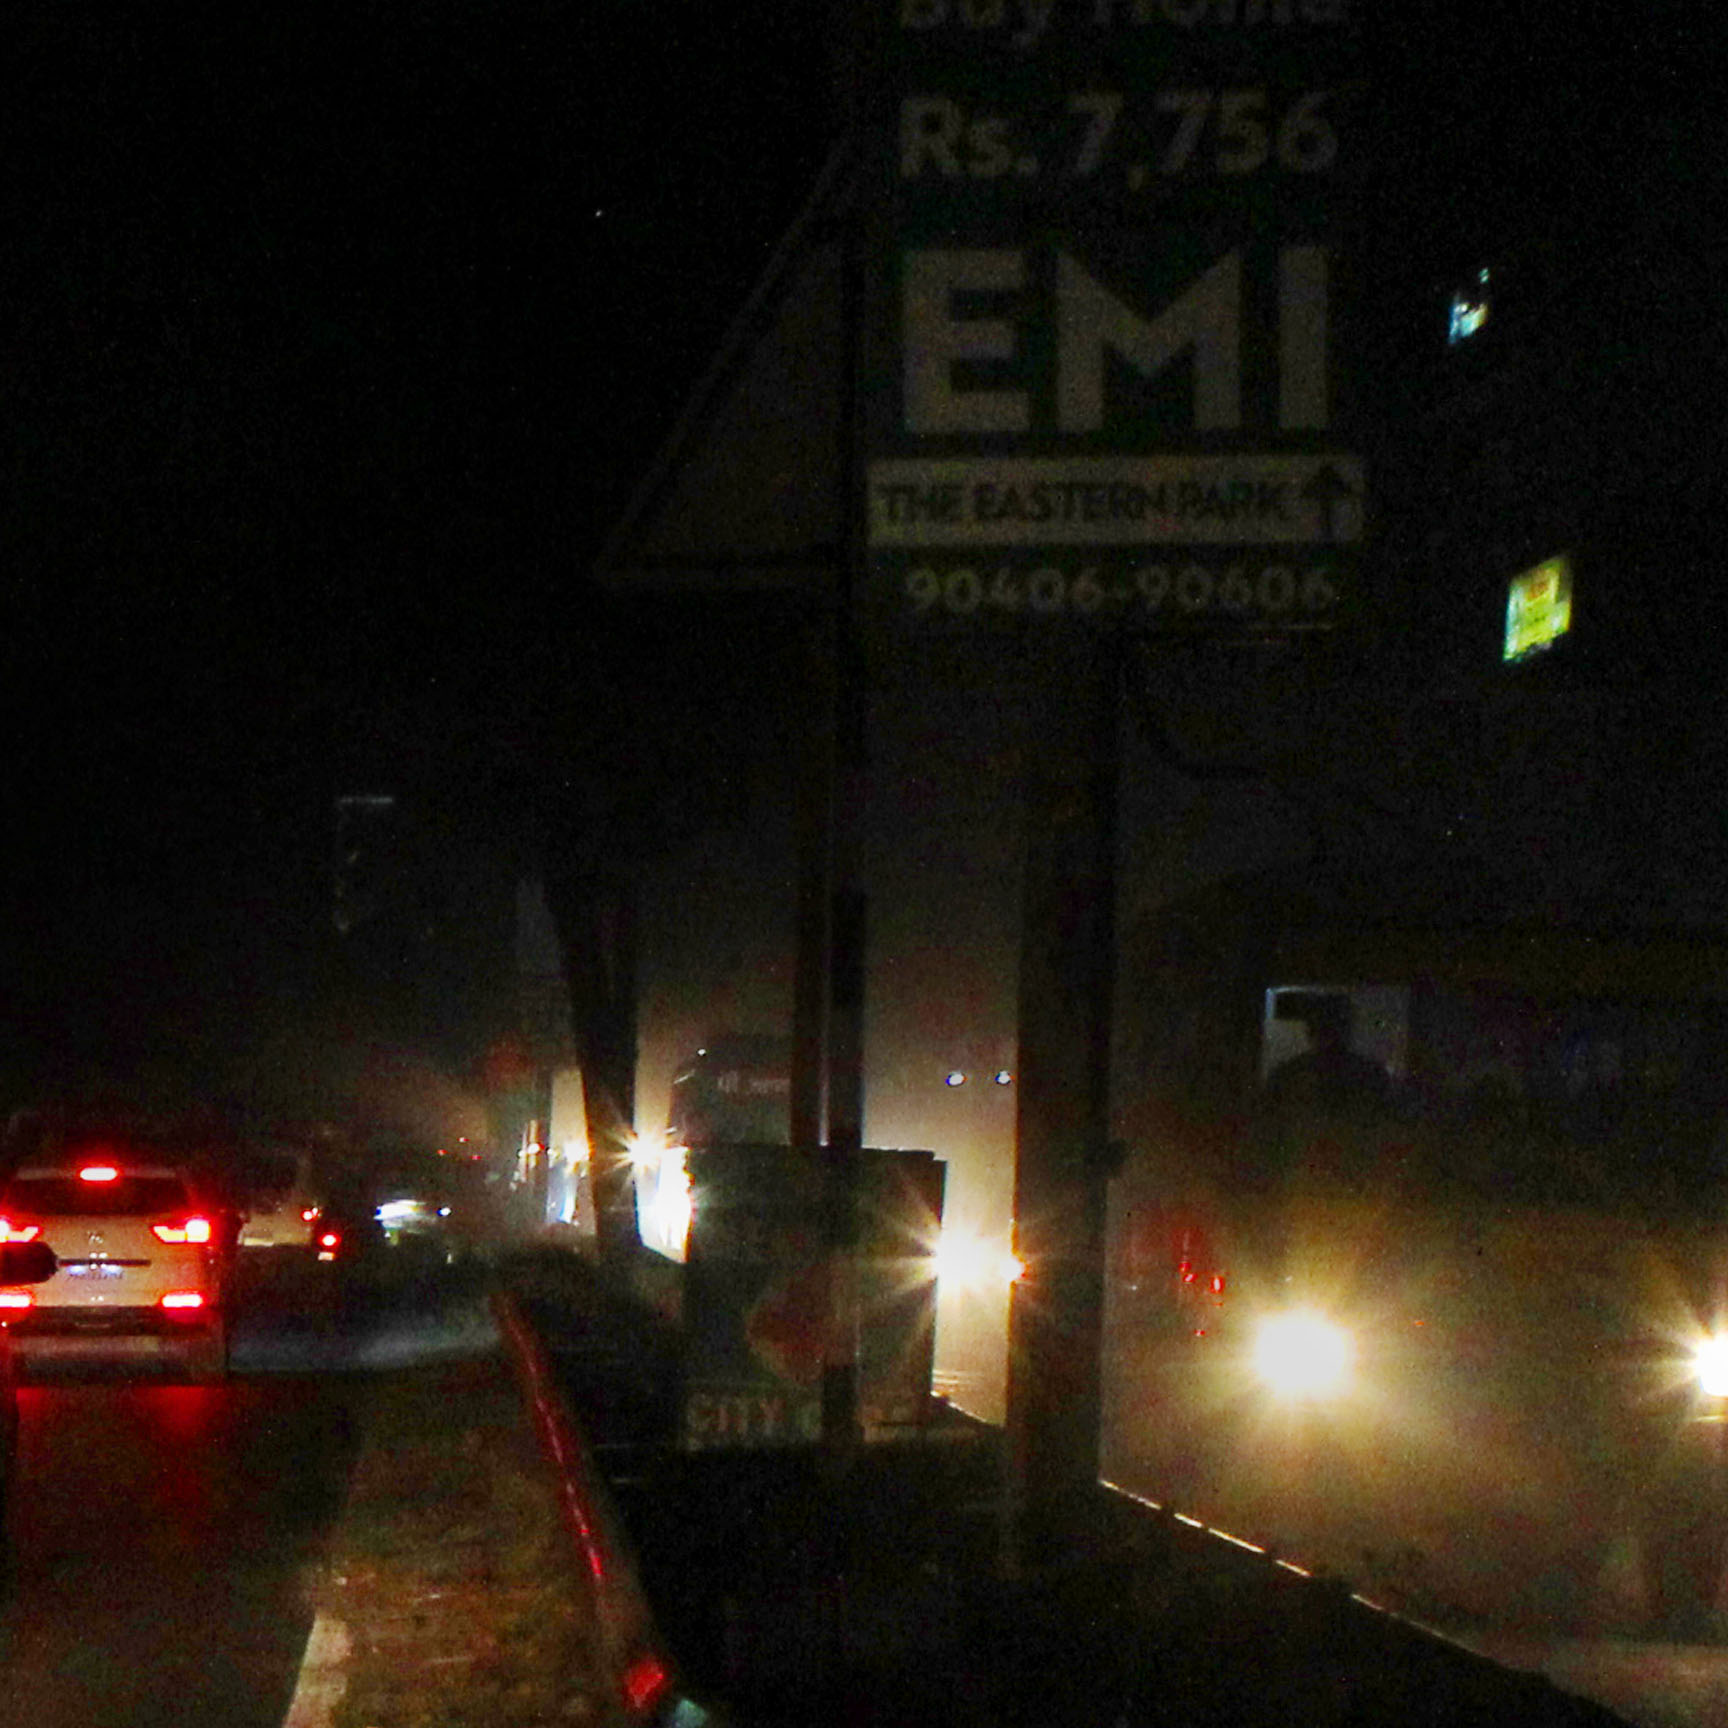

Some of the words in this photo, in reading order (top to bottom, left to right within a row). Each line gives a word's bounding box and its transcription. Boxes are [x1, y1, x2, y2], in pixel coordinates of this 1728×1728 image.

[898, 91, 1040, 179] Rs.
[1066, 88, 1339, 190] 7,756
[902, 245, 1329, 434] EMI
[882, 483, 964, 522] THE
[973, 481, 1167, 522] EASTERN
[1178, 481, 1292, 521] PARK
[904, 566, 1340, 614] 90406-90606
